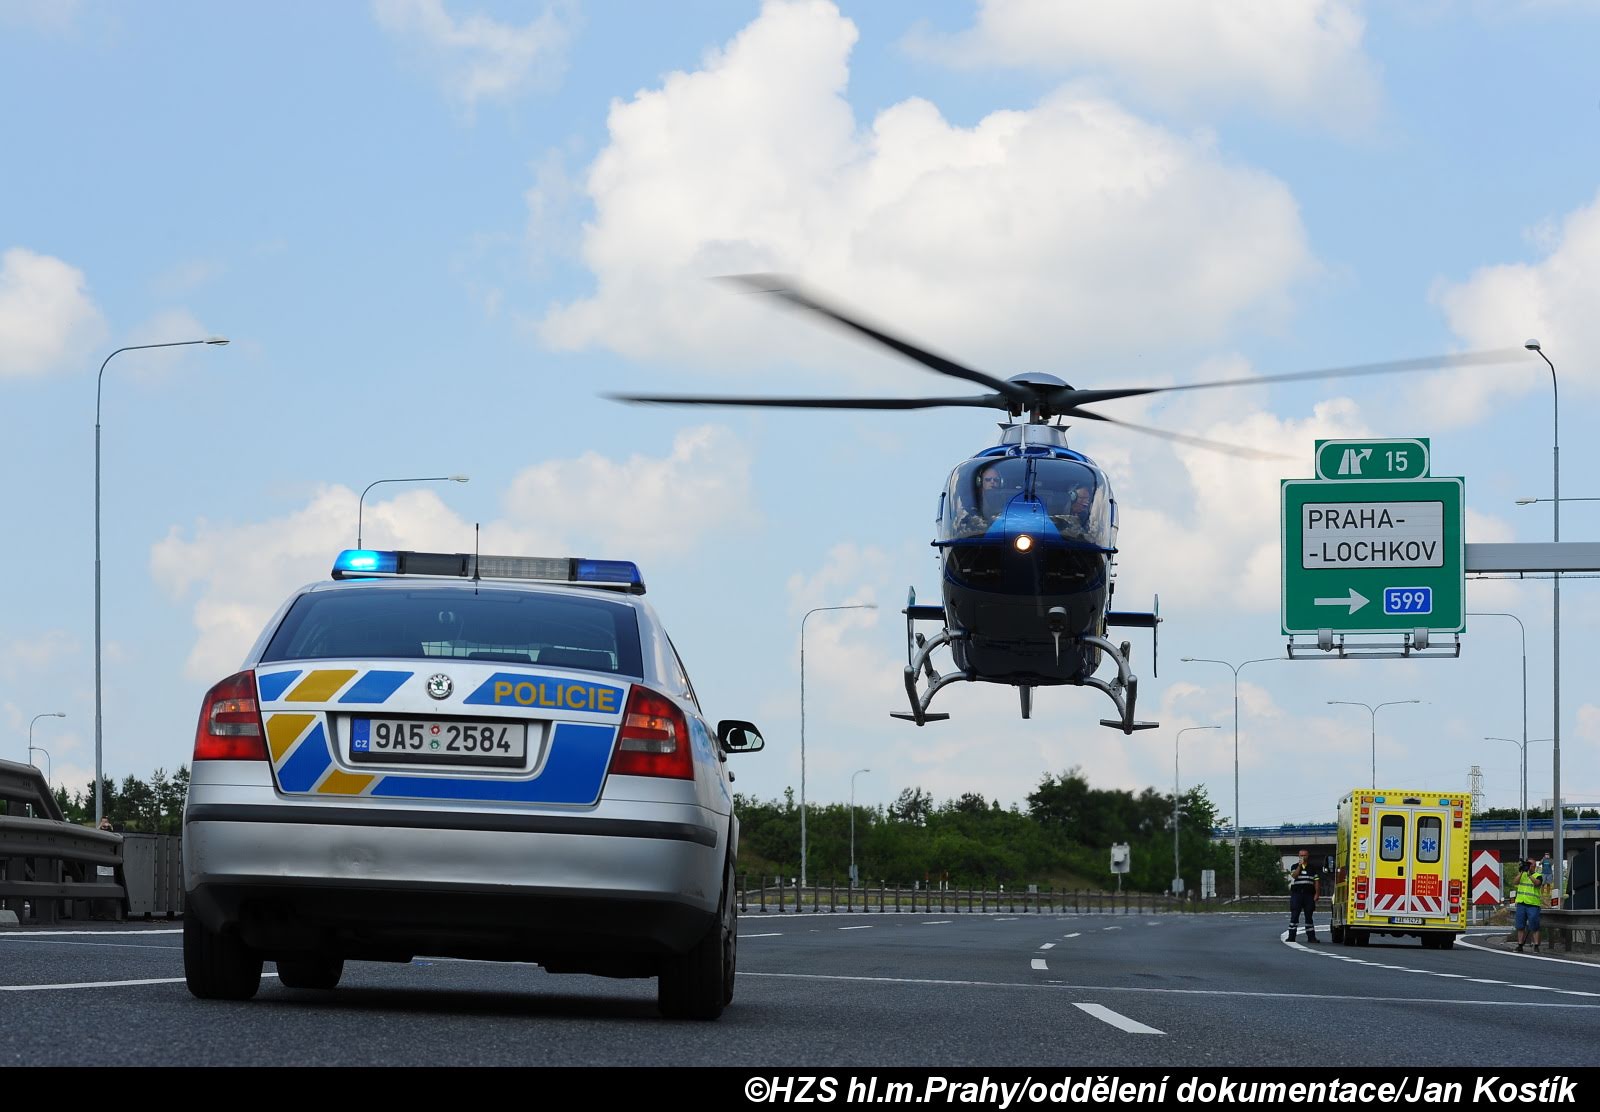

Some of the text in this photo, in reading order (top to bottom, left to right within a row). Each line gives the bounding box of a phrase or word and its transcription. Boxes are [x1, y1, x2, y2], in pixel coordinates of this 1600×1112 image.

[1385, 451, 1408, 471] 15
[1308, 508, 1406, 530] PRAHA-
[1309, 540, 1437, 562] -LOCHKOV
[1390, 591, 1425, 610] 599
[494, 681, 616, 711] POLICIE
[355, 740, 368, 748] CZ
[375, 723, 511, 753] 9A5 2584
